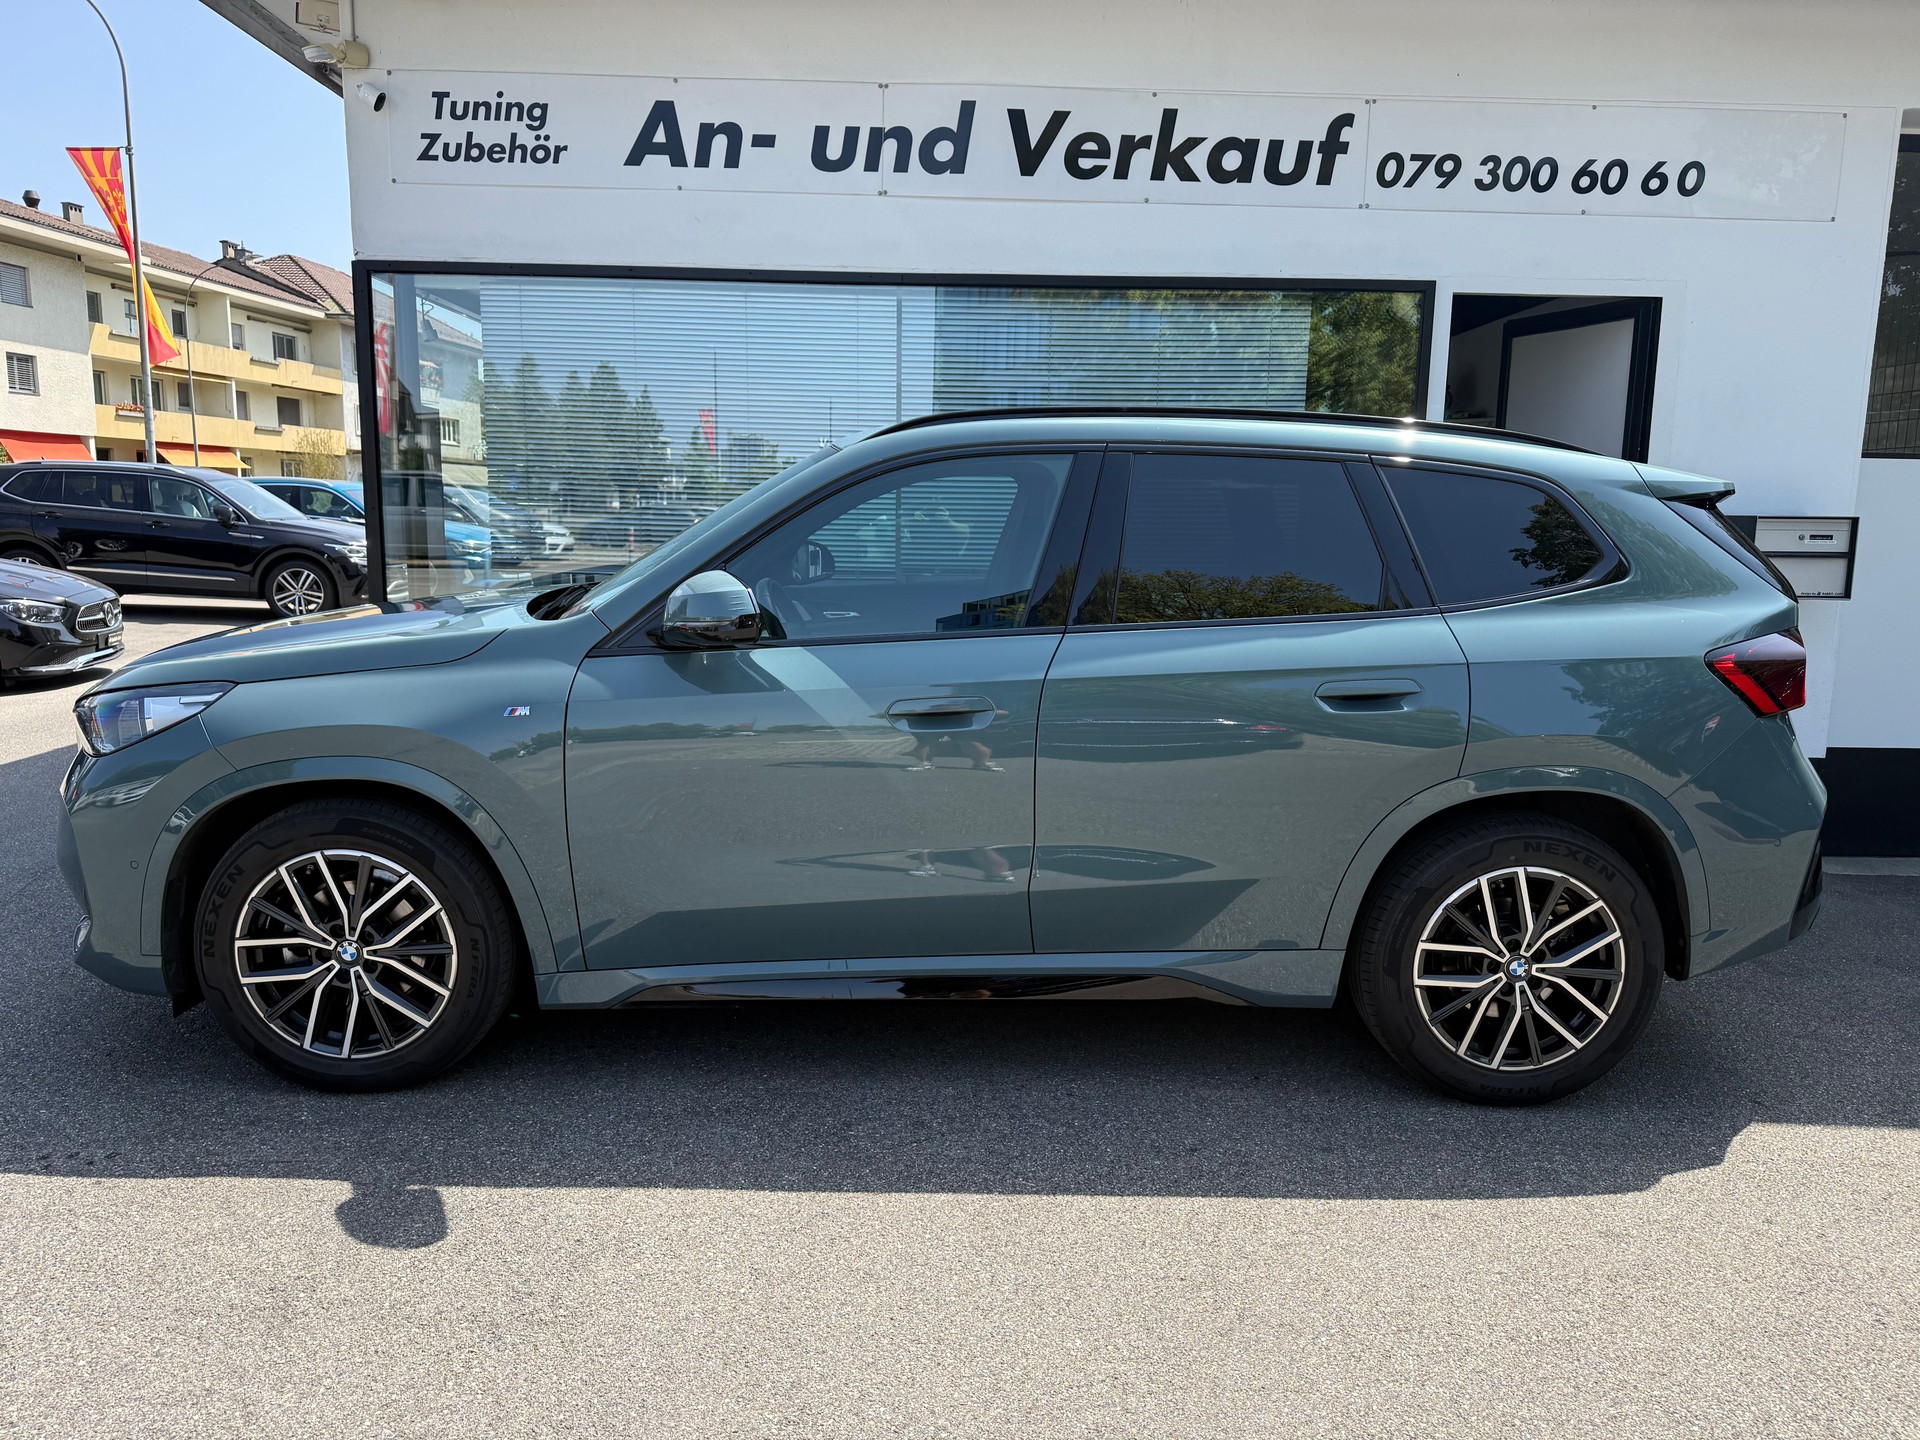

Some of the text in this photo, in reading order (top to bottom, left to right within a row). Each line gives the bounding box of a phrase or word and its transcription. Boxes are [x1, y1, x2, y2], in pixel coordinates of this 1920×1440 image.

[431, 90, 549, 132] Tuning
[416, 132, 569, 165] Zubehör
[623, 99, 1357, 187] An- und Verkauf
[1376, 151, 1463, 189] 079
[1474, 154, 1559, 194] 300
[1570, 158, 1629, 196] 60
[1522, 840, 1618, 882] NEXEN
[203, 863, 246, 958] NEXEN
